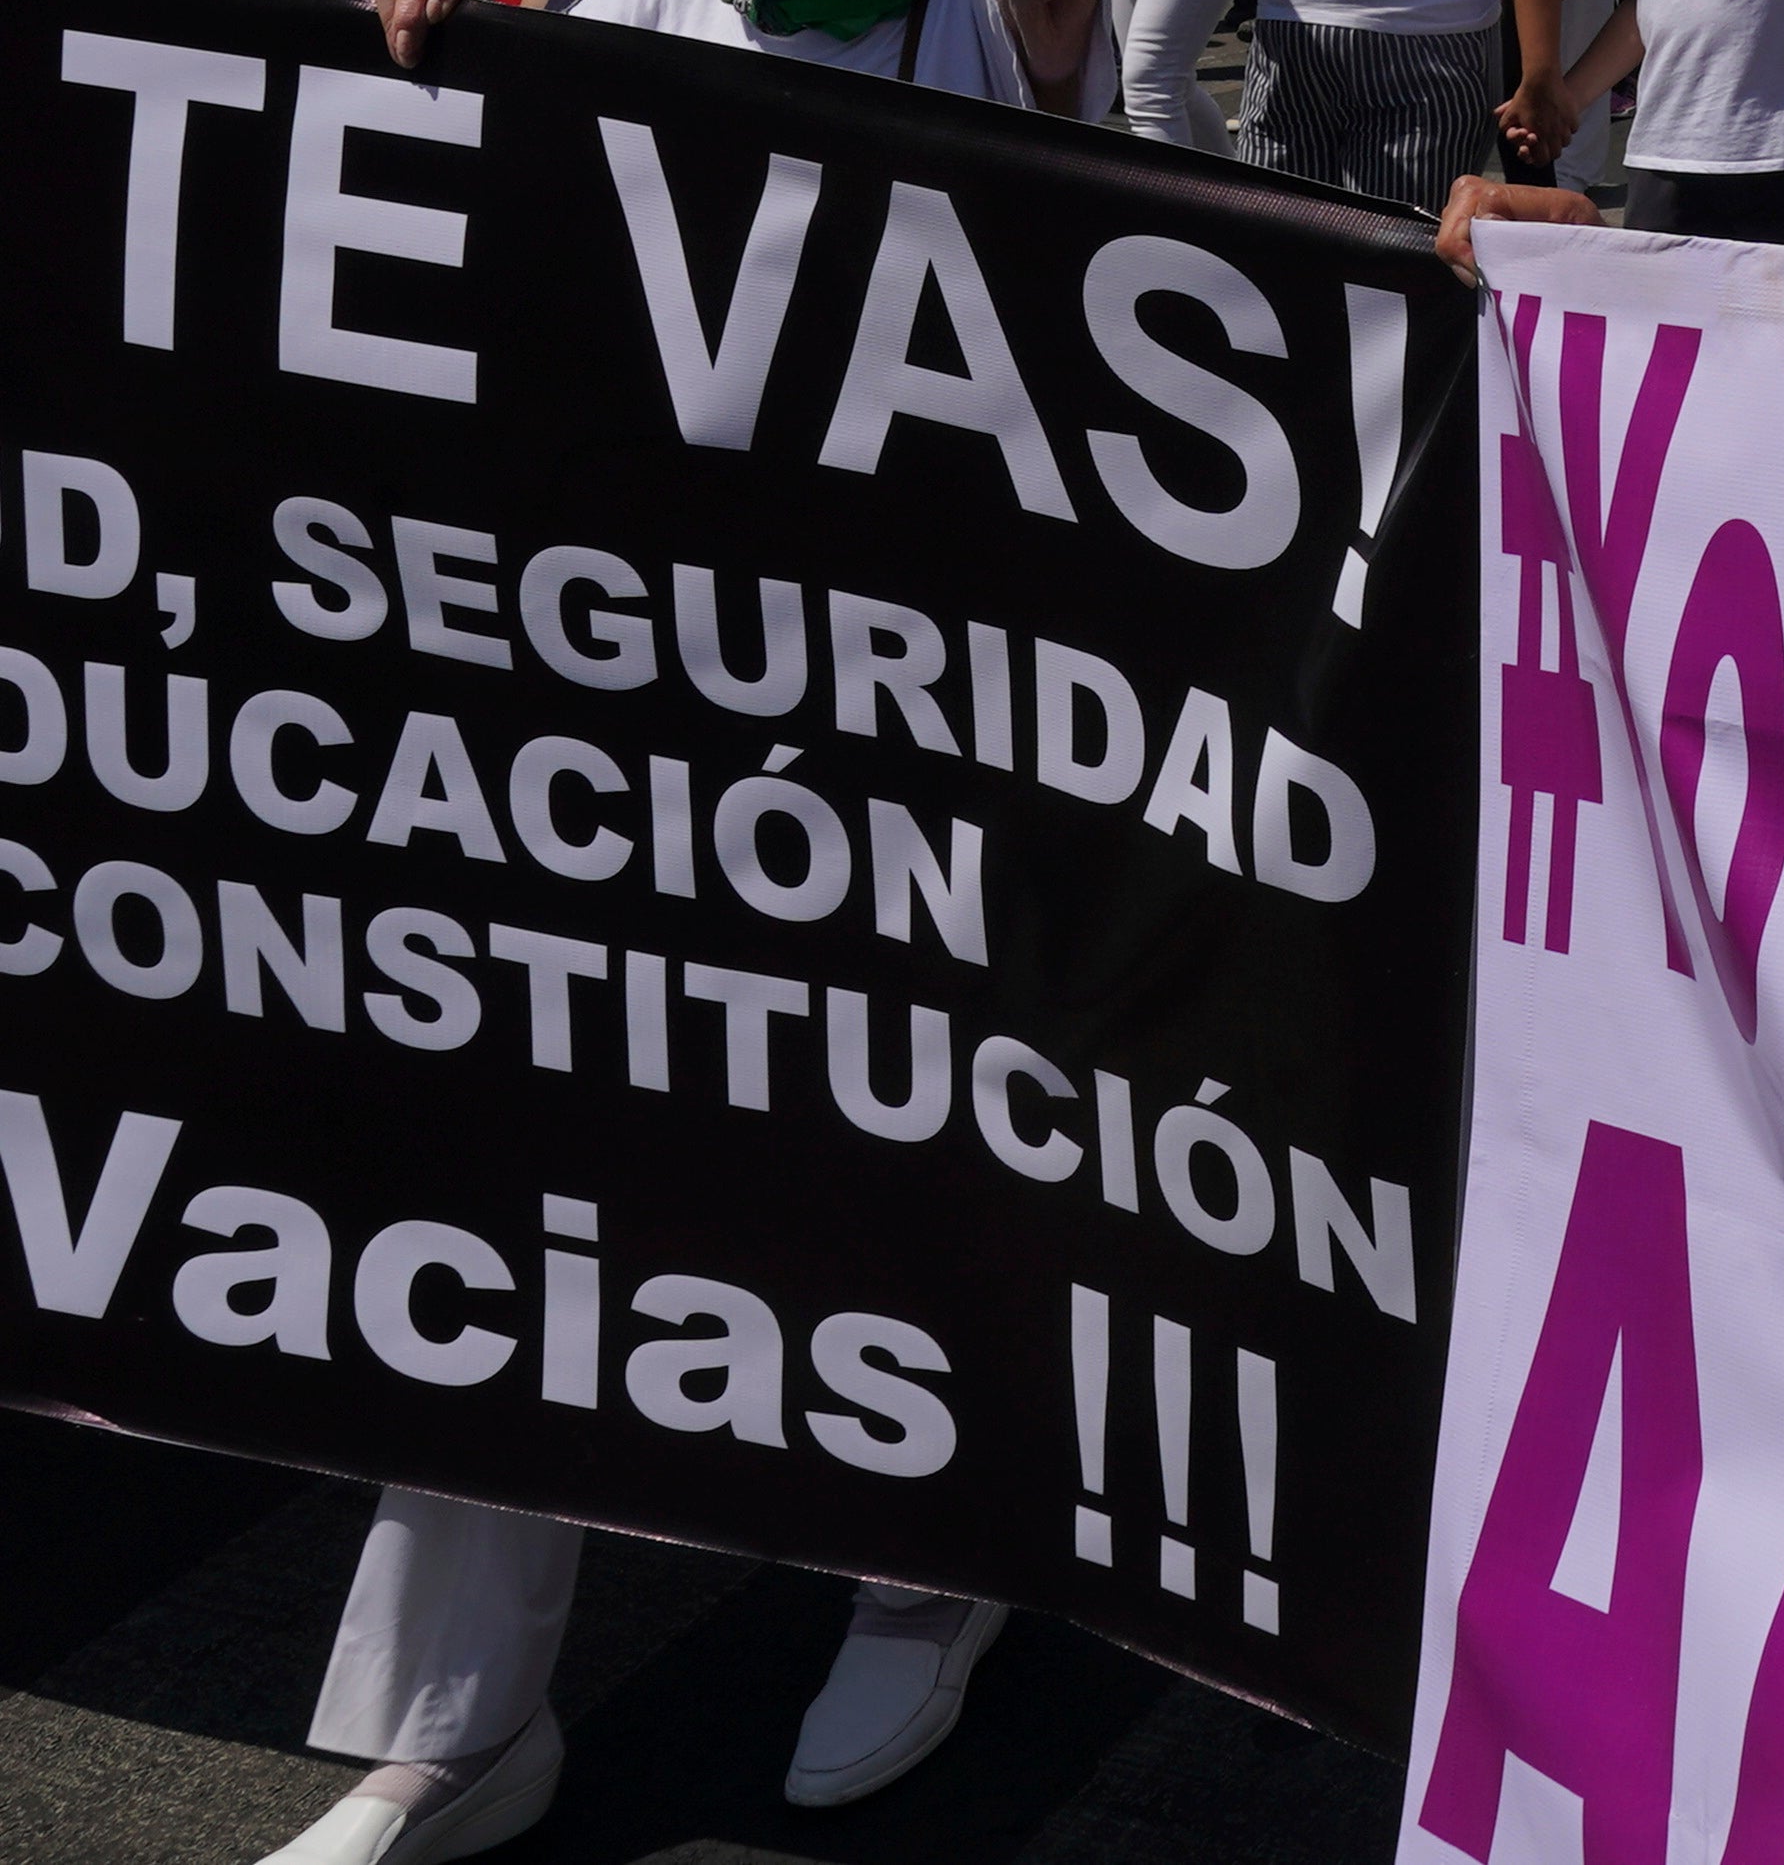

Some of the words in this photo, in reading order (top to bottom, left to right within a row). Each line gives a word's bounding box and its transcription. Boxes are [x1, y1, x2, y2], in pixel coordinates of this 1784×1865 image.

[60, 28, 485, 405] TE
[597, 115, 1409, 632] VAS!
[21, 448, 198, 652] D,
[271, 493, 1378, 904] SEGURIDAD
[0, 837, 1418, 1327] CONSTITUCIÓN
[0, 1088, 959, 1482] Vacias
[1069, 1282, 1283, 1637] !!!
